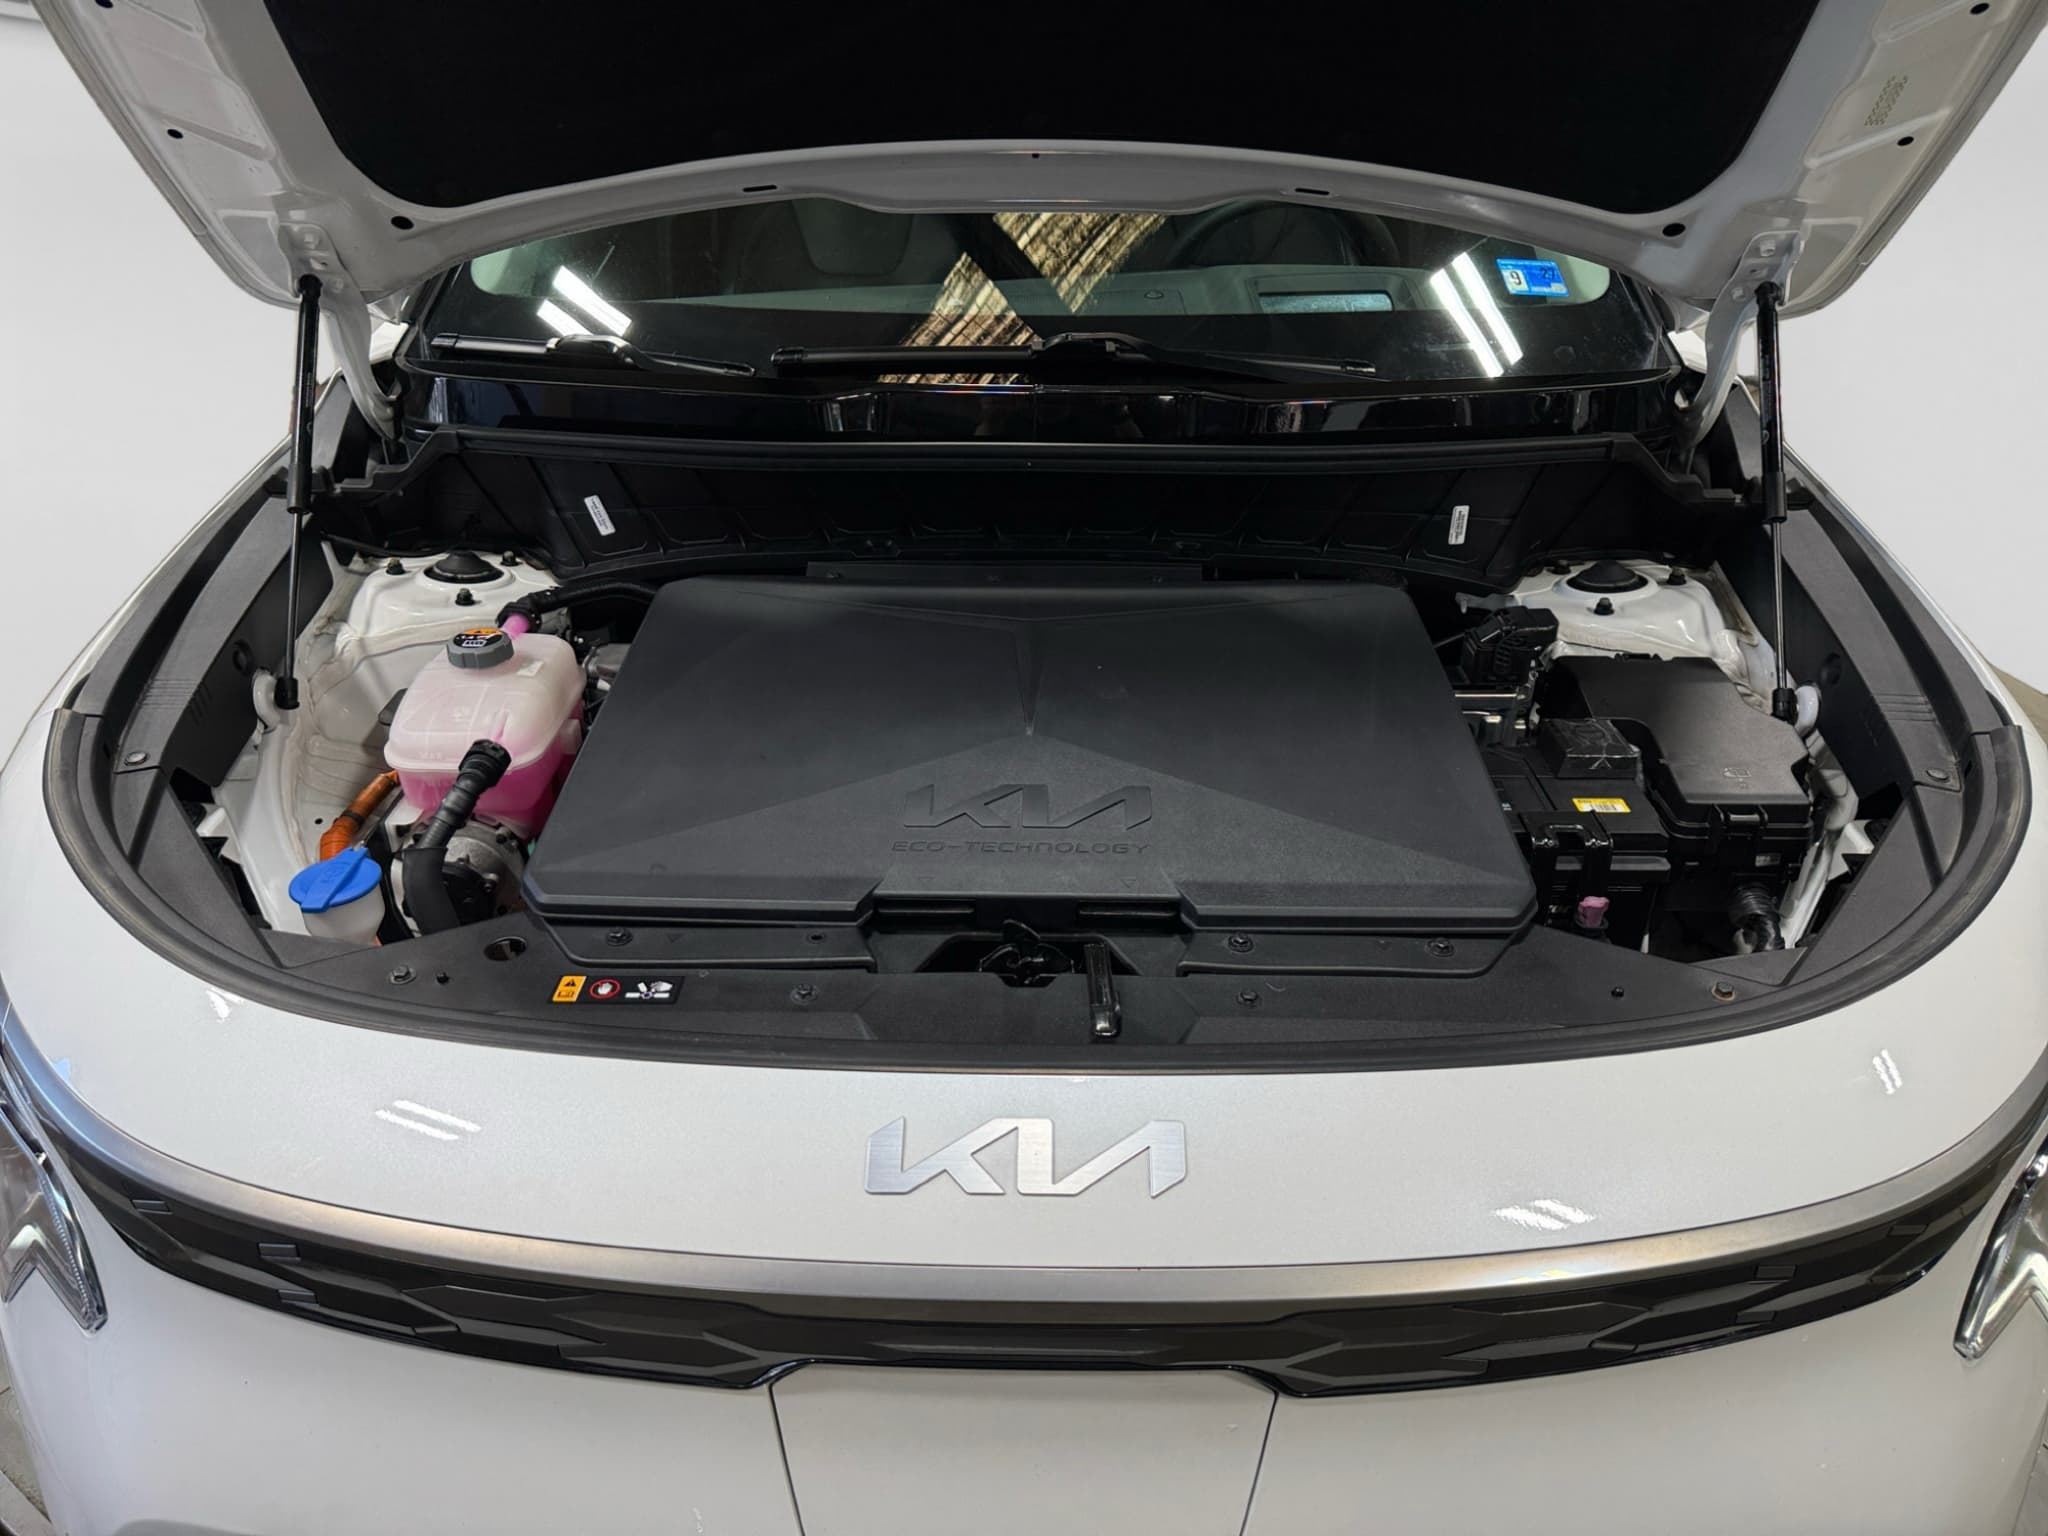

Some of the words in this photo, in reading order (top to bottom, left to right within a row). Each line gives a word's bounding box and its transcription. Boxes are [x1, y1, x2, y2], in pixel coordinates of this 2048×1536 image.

[1510, 270, 1522, 286] 9
[903, 783, 1153, 831] KIA
[891, 840, 1152, 854] ECO-TECHNOLOGY
[864, 1116, 1186, 1199] KIA
